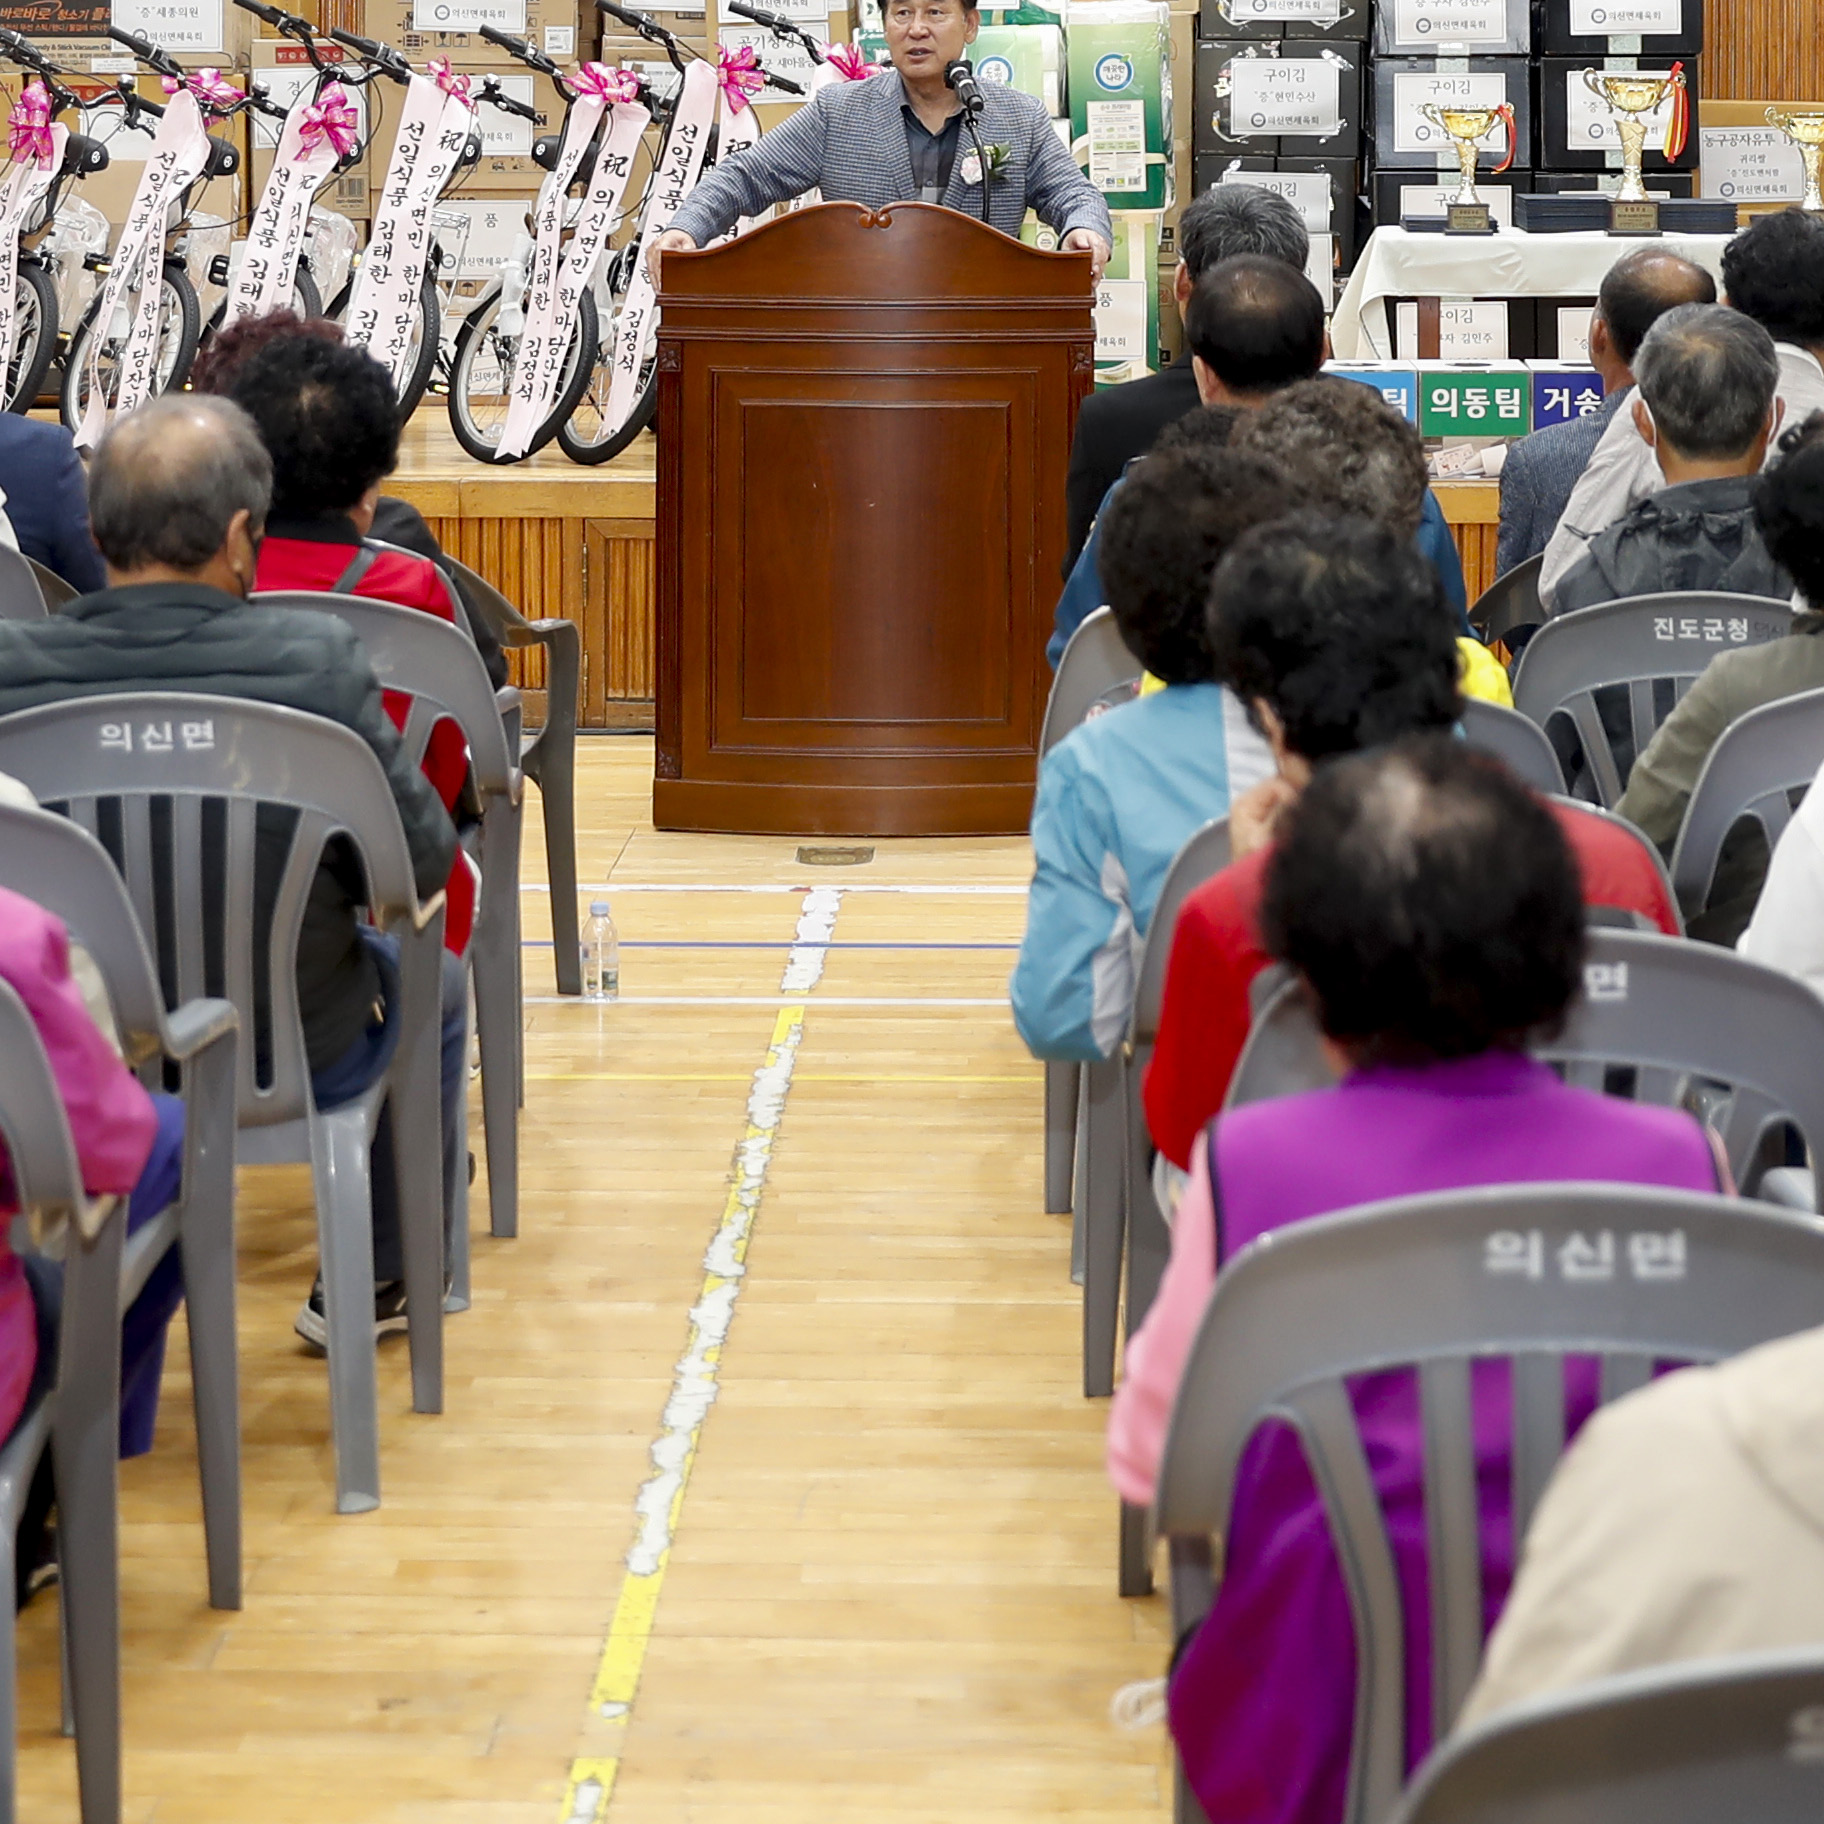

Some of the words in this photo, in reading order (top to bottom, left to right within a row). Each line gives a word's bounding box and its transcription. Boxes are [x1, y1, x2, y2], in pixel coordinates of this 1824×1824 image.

[0, 6, 52, 21] 바로바로
[451, 8, 507, 20] 의신면체육회
[1432, 19, 1487, 31] 의신면체육회
[1608, 9, 1662, 22] 의신면체육회
[149, 29, 204, 43] 의신면체육회
[1263, 68, 1306, 84] 구이김
[1427, 79, 1471, 95] 구이김
[439, 127, 468, 153] 祝
[1703, 132, 1776, 148] 농구공자유투
[385, 120, 426, 209] 선일식품
[599, 151, 631, 179] 祝
[657, 121, 699, 212] 선일식품
[405, 162, 448, 251] 의신면민
[569, 188, 615, 276] 의신면민
[368, 219, 397, 287] 김태한
[532, 246, 554, 312] 김태한
[120, 299, 161, 413] 한마당잔치
[616, 307, 645, 375] 김정석
[514, 336, 543, 403] 김정석
[1430, 387, 1522, 419] 의동팀
[1653, 616, 1750, 644] 진도군청
[97, 717, 217, 754] 의신면
[1482, 1230, 1689, 1282] 의신면
